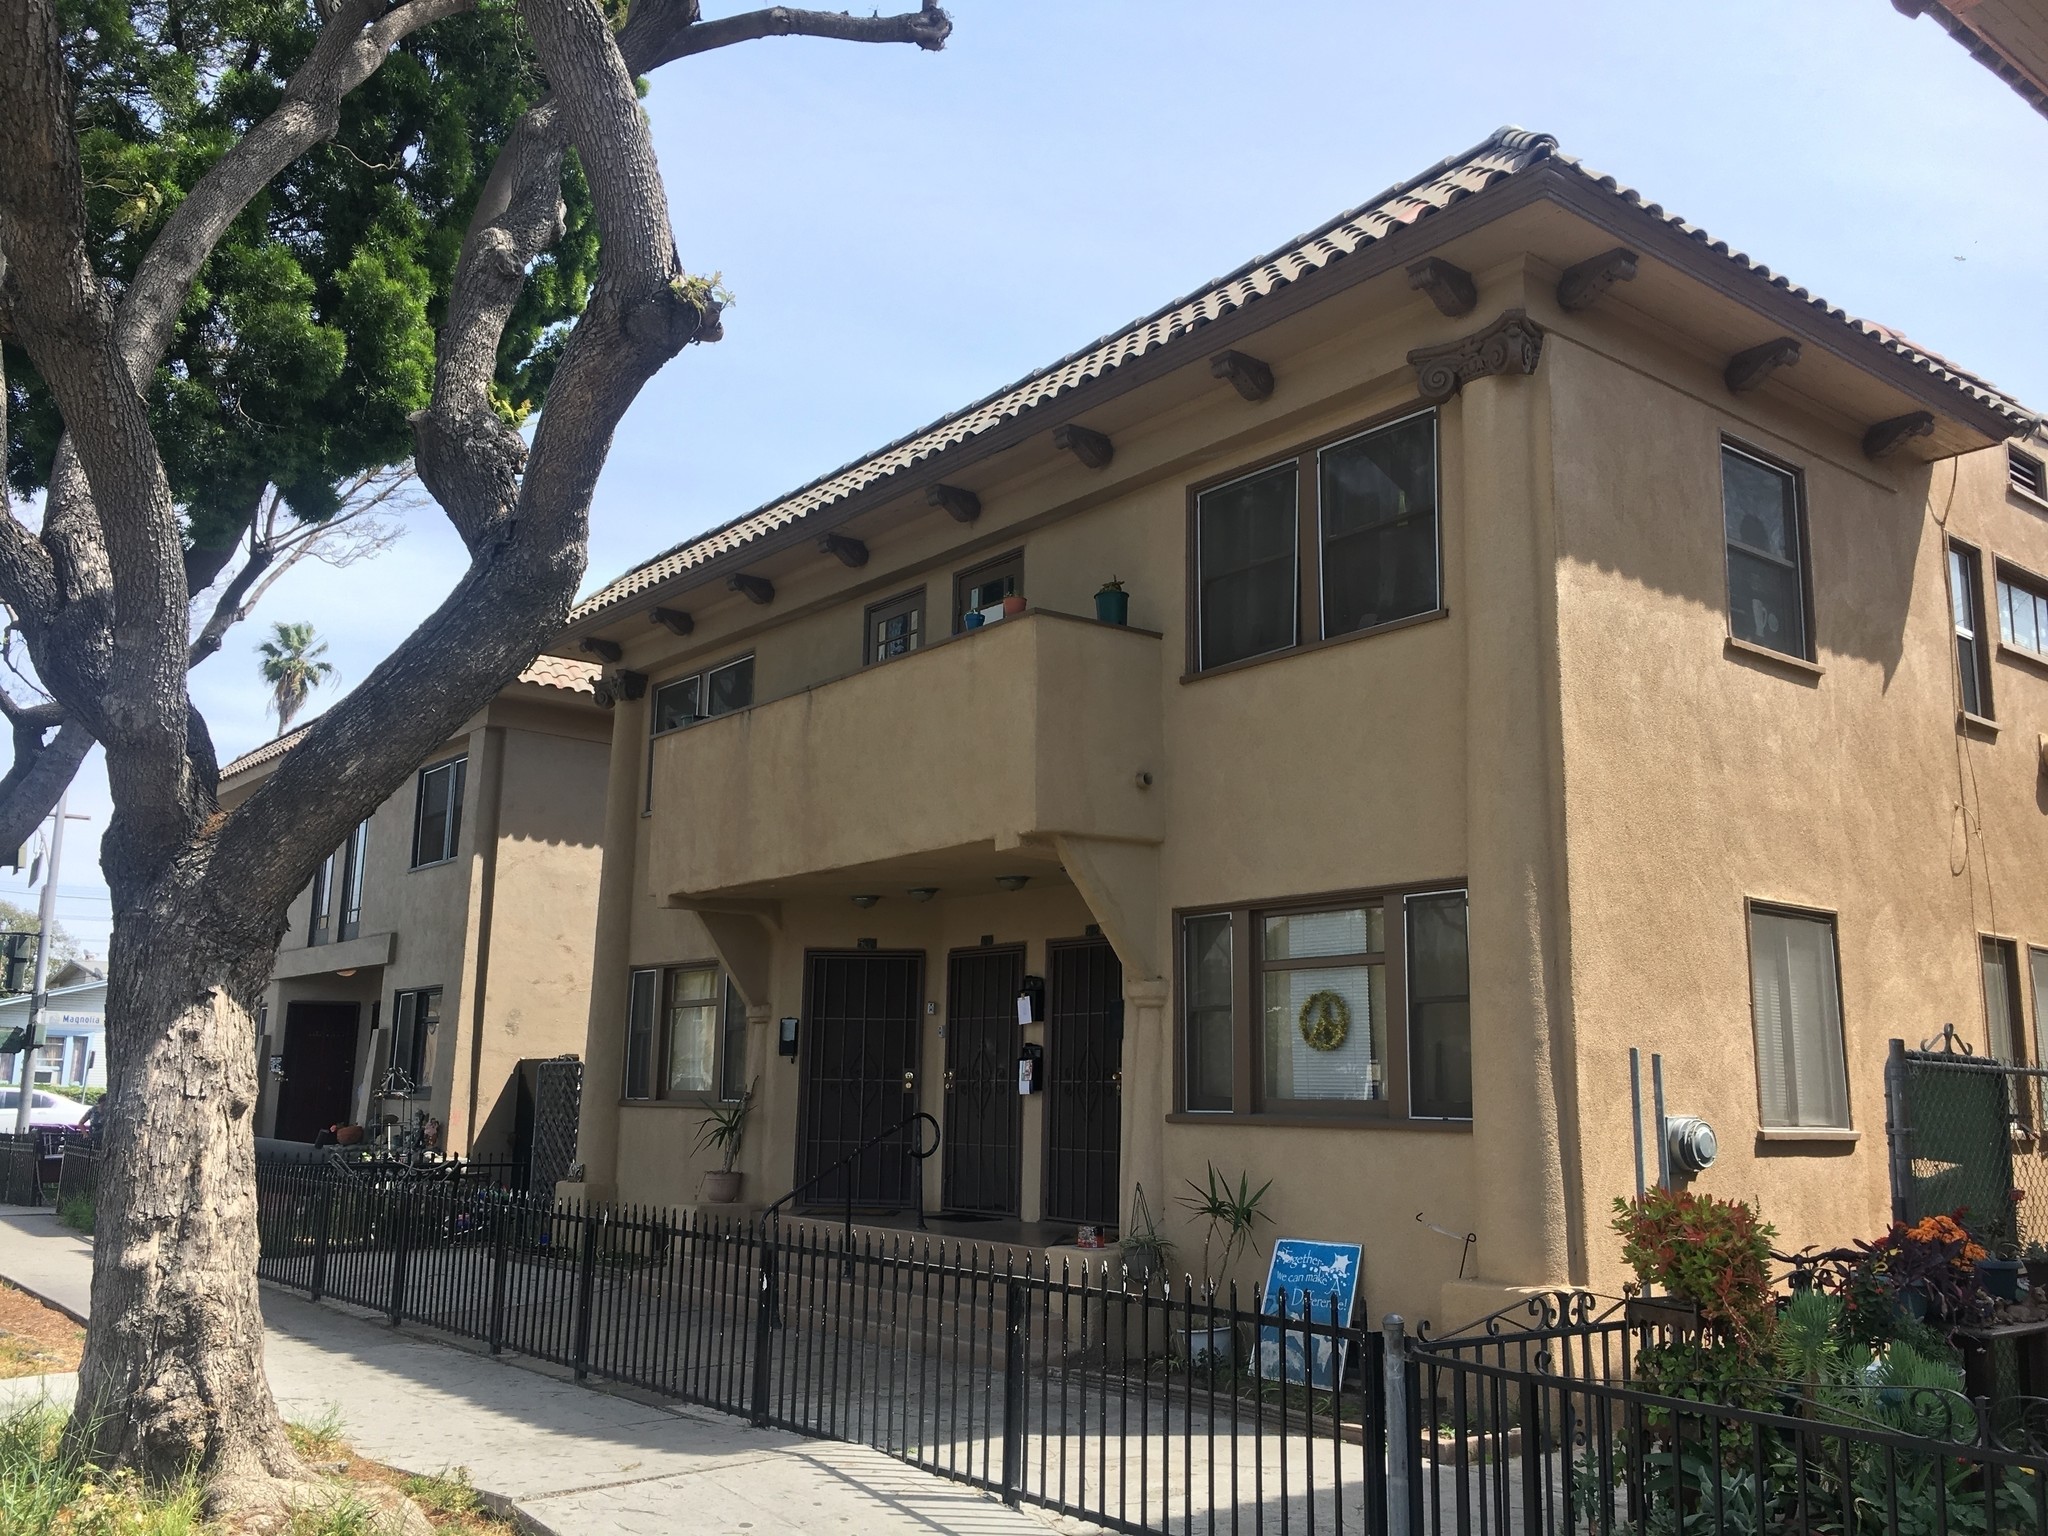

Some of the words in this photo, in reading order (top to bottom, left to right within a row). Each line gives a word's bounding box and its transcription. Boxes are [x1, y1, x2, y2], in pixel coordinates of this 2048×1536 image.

[62, 1014, 100, 1024] Magnolia
[1287, 1274, 1304, 1283] can
[1305, 1268, 1328, 1286] make
[1324, 1277, 1342, 1296] A
